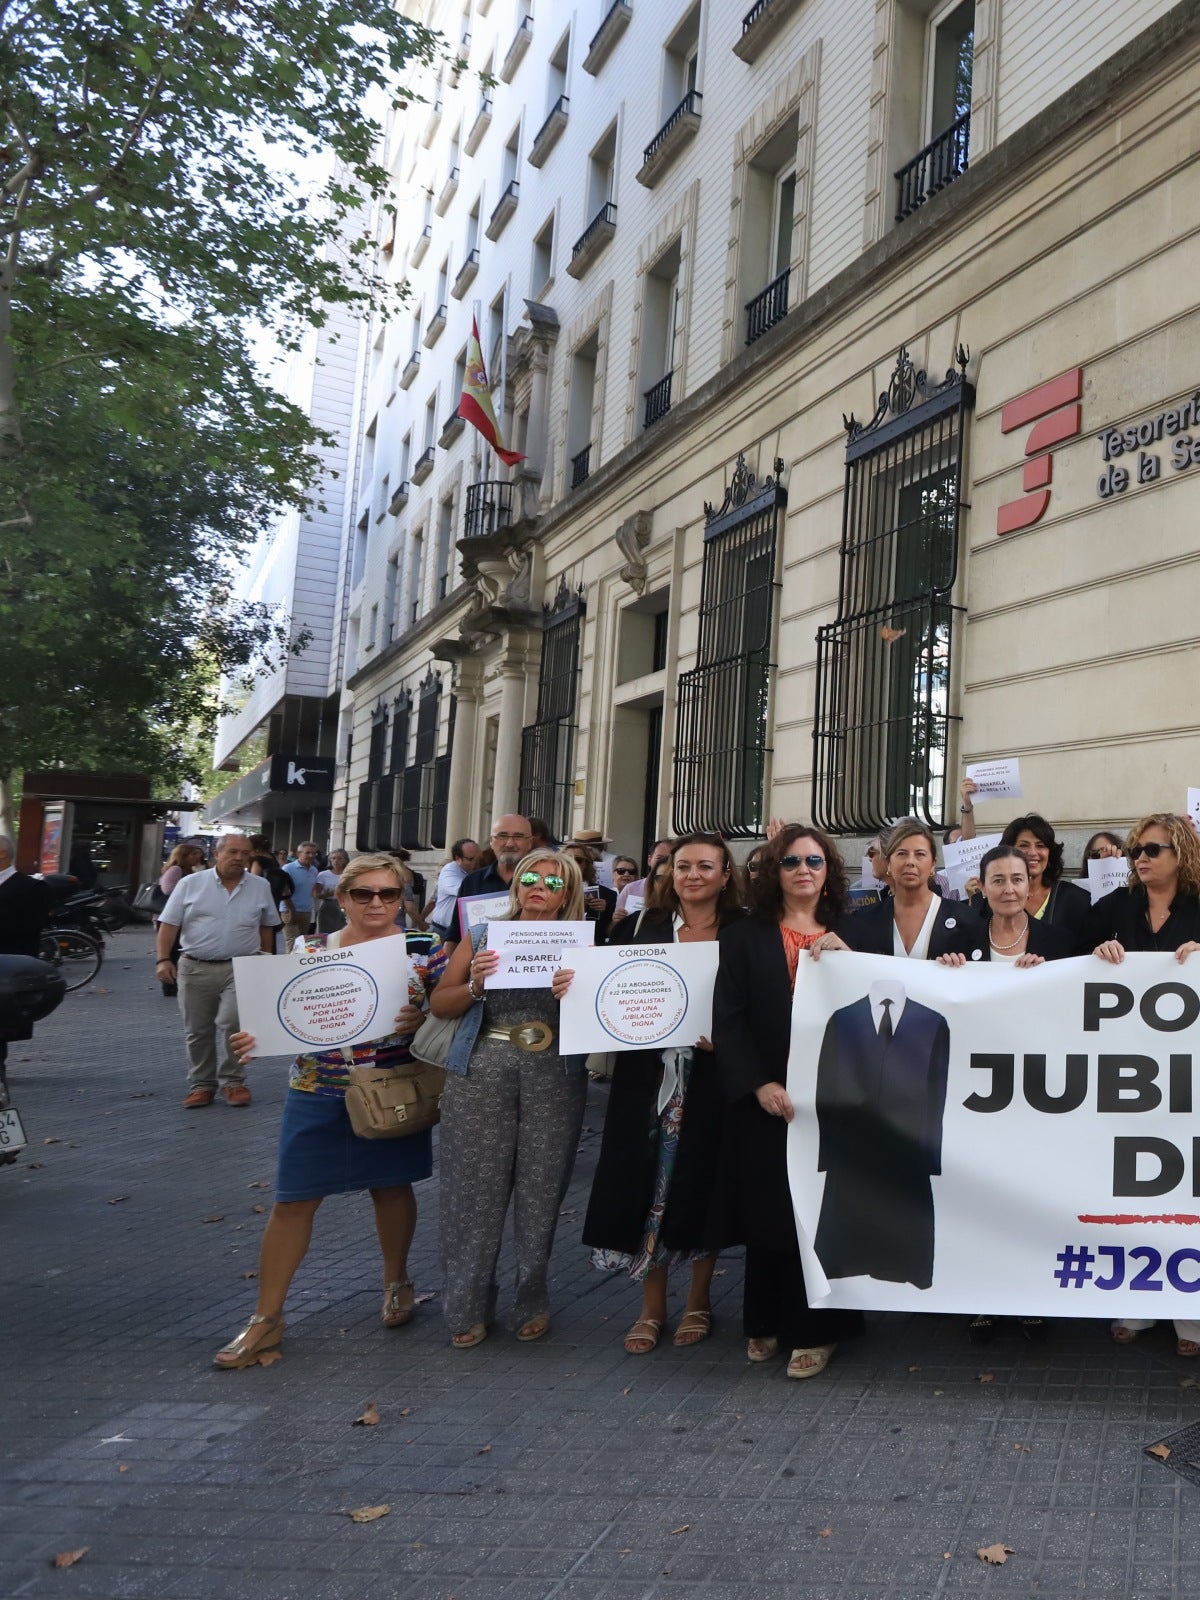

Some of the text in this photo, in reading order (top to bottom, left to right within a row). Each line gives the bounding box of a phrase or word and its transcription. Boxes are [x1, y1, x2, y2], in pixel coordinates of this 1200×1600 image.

[1096, 464, 1128, 498] de
[1137, 451, 1160, 484] la
[299, 950, 354, 966] CÓRDOBA
[508, 966, 520, 974] AL
[314, 982, 354, 993] ABOGADOS
[621, 987, 672, 995] PROCURADORES
[306, 987, 362, 1001] PROCURADORES
[303, 997, 356, 1011] MUTUALISTAS
[618, 997, 666, 1006] MUTUALISTAS
[308, 1012, 354, 1024] JUBILACIÓN
[348, 1003, 375, 1036] MUTUALISTAS
[621, 1012, 662, 1020] JUBILACIÓN
[320, 1021, 346, 1030] DIGNA
